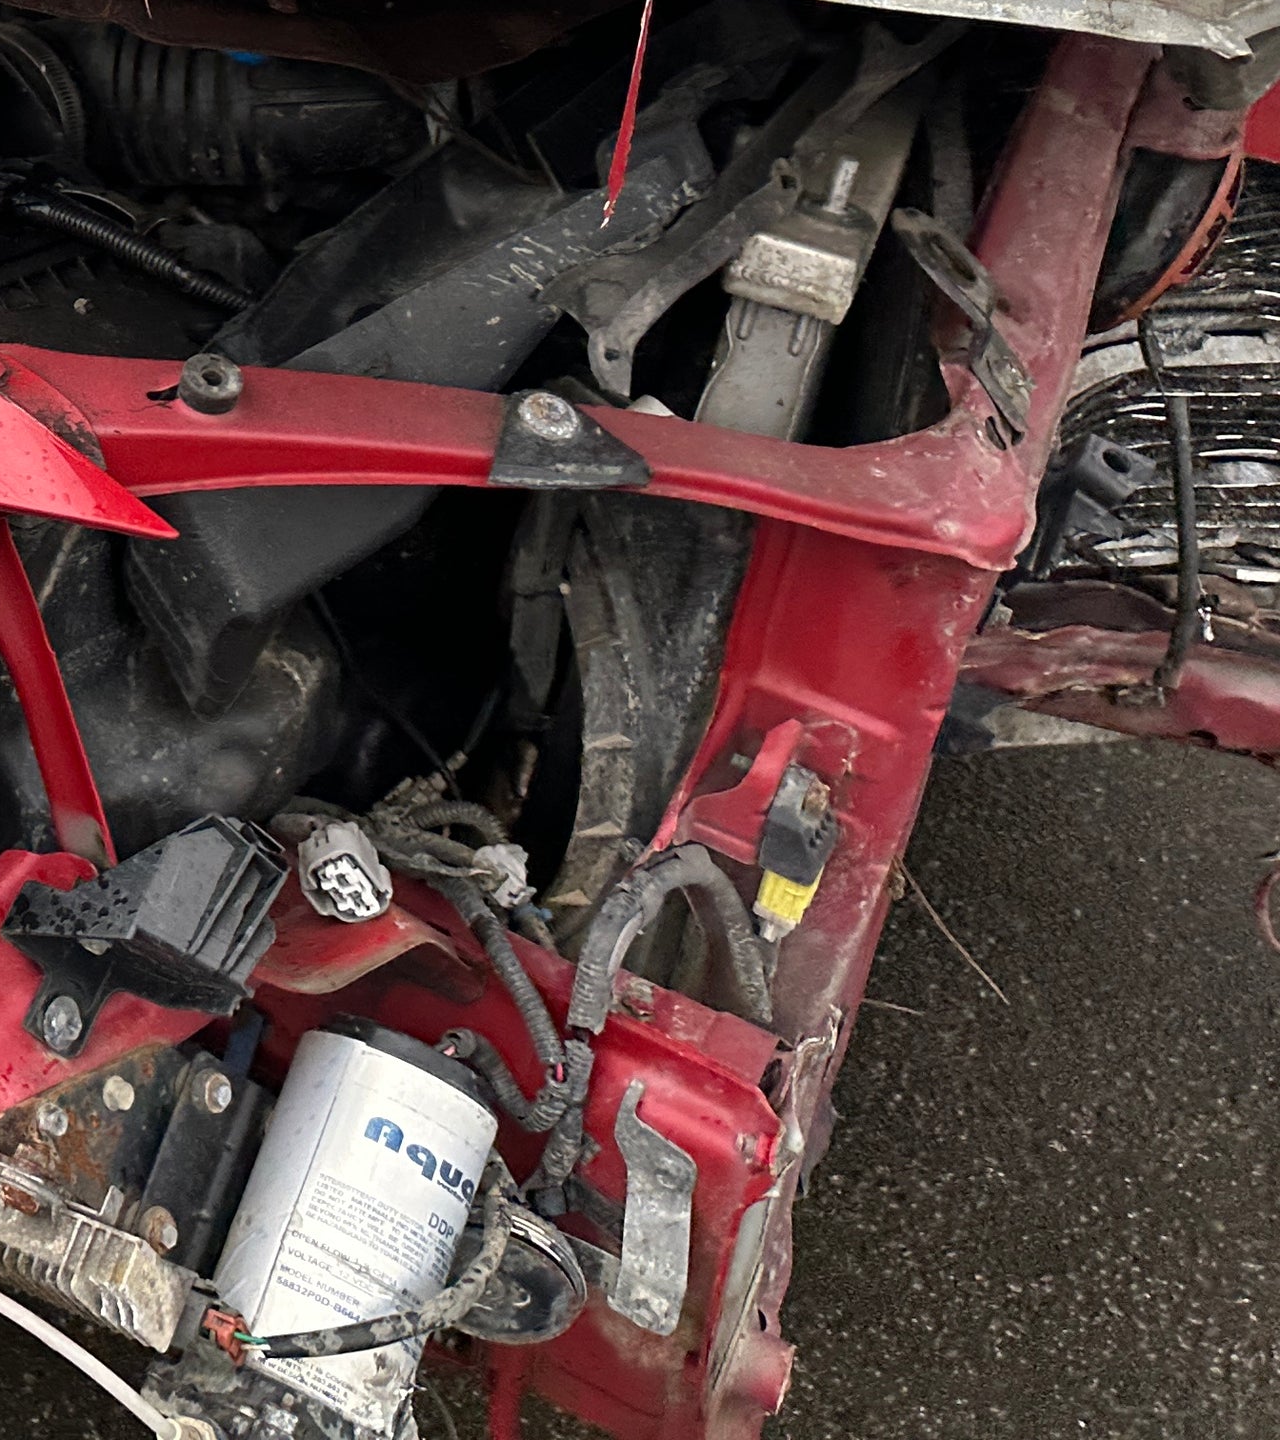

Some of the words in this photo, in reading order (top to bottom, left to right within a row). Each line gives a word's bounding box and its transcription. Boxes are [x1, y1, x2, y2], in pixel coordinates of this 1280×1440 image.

[287, 1246, 332, 1272] VOLTAGE
[279, 1264, 313, 1284] MODEL
[314, 1280, 361, 1307] NUMBER
